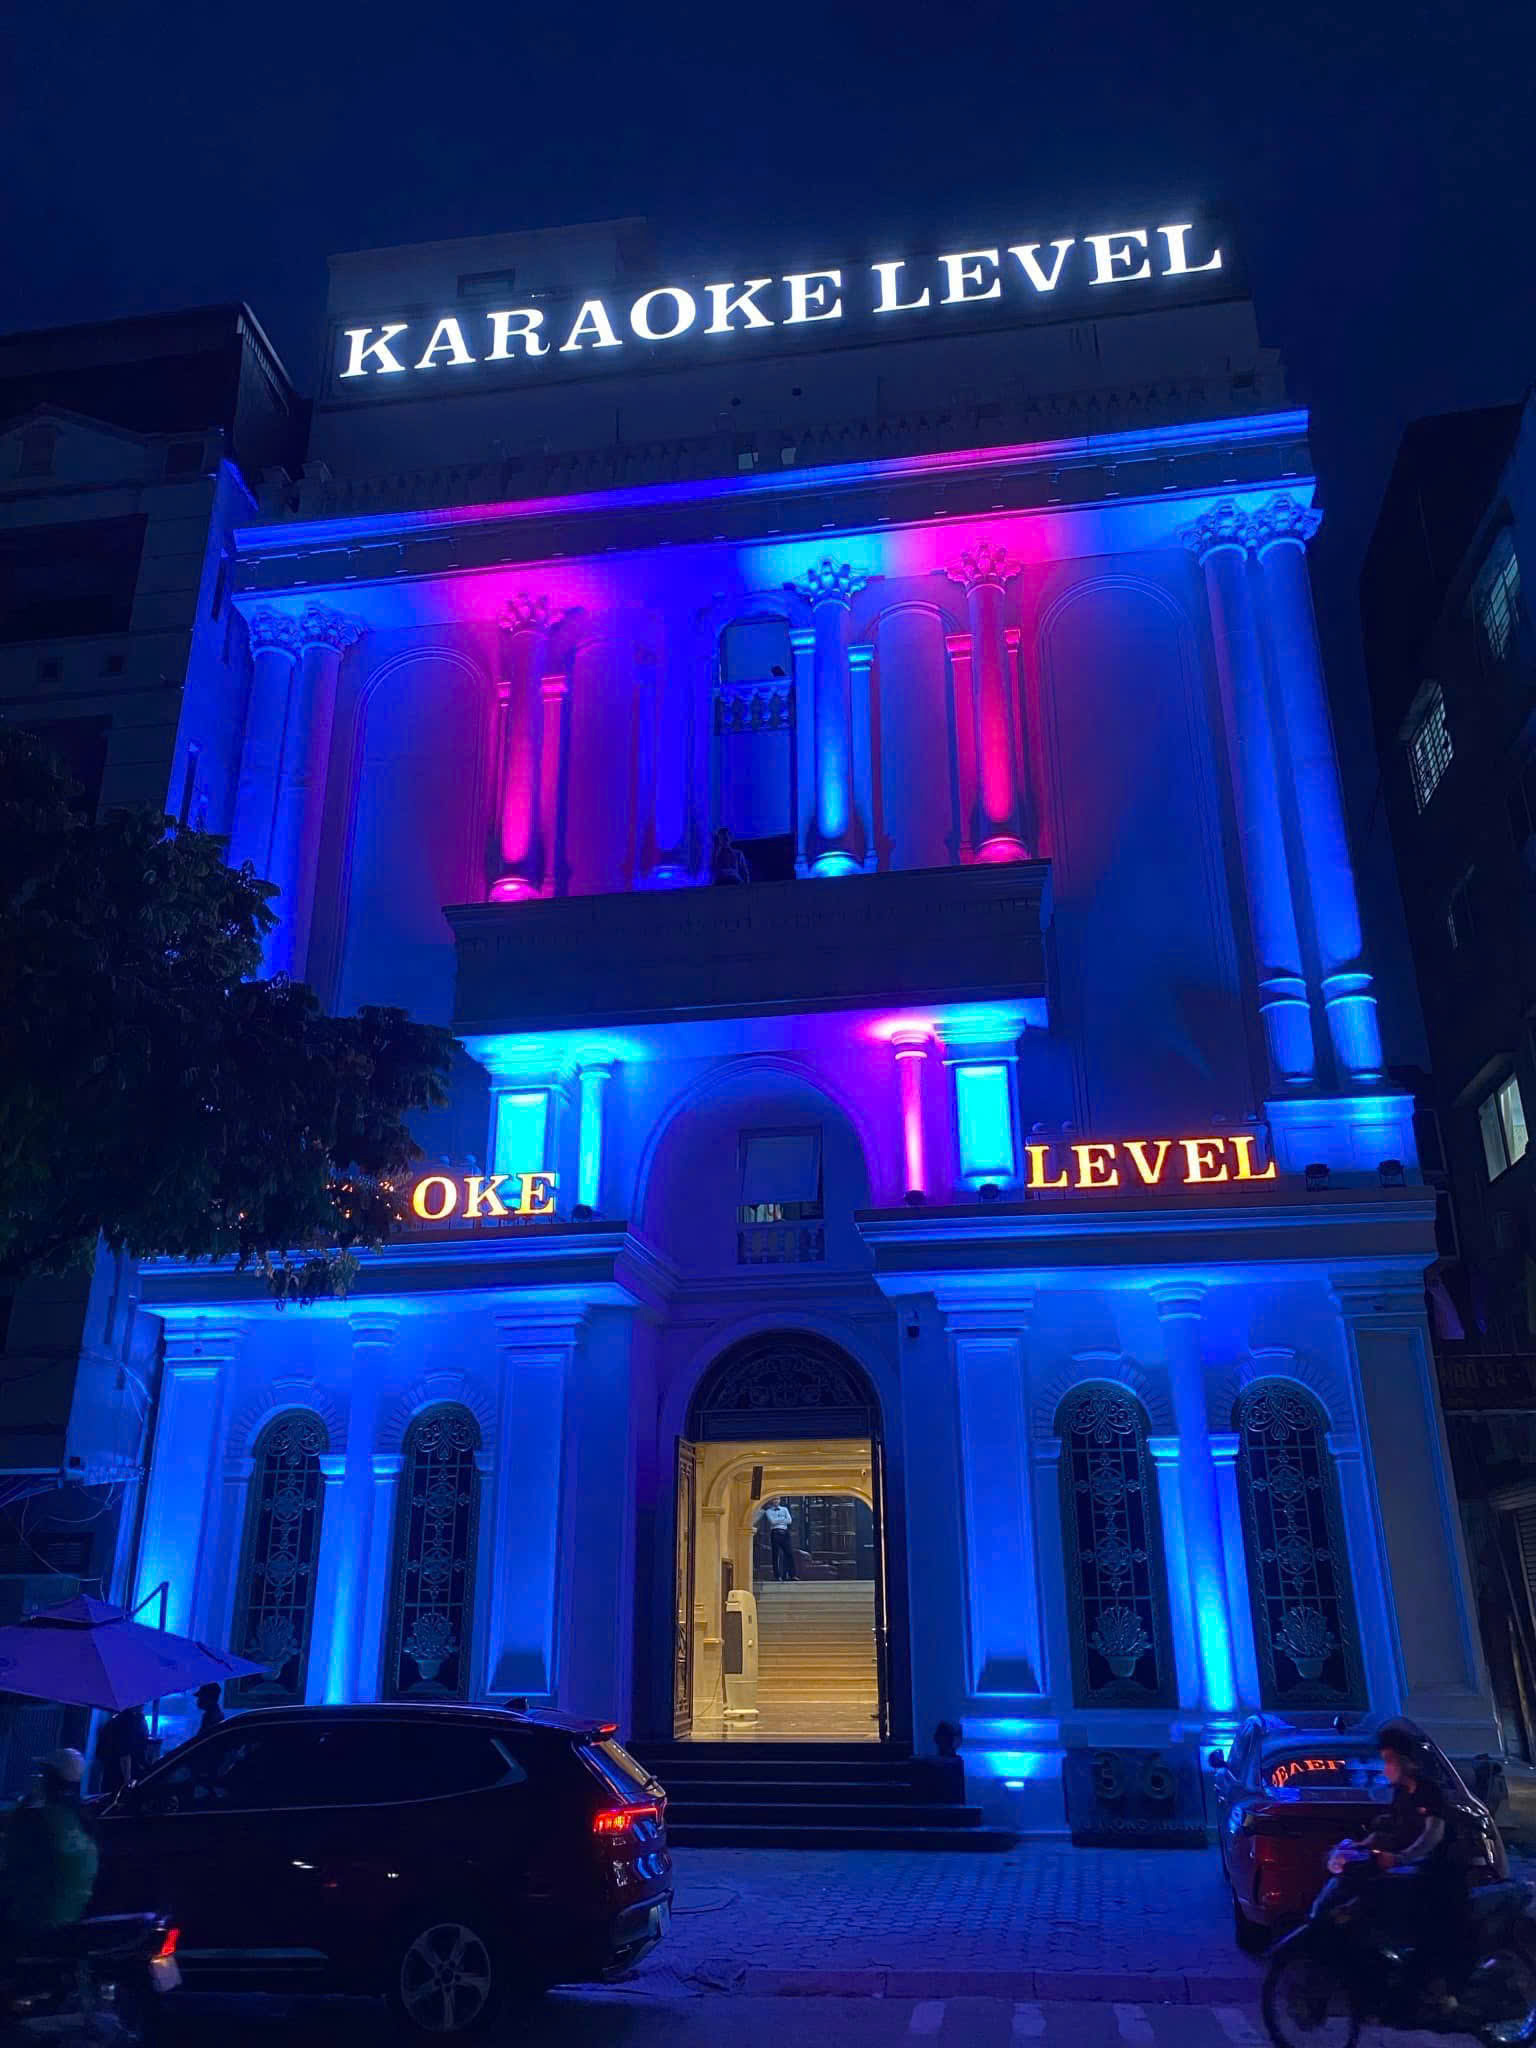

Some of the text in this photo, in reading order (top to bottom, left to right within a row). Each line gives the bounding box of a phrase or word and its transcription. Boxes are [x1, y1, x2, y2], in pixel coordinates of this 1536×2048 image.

[339, 223, 1222, 378] KARAOKE LEVEL
[1024, 1136, 1276, 1188] LEVEL
